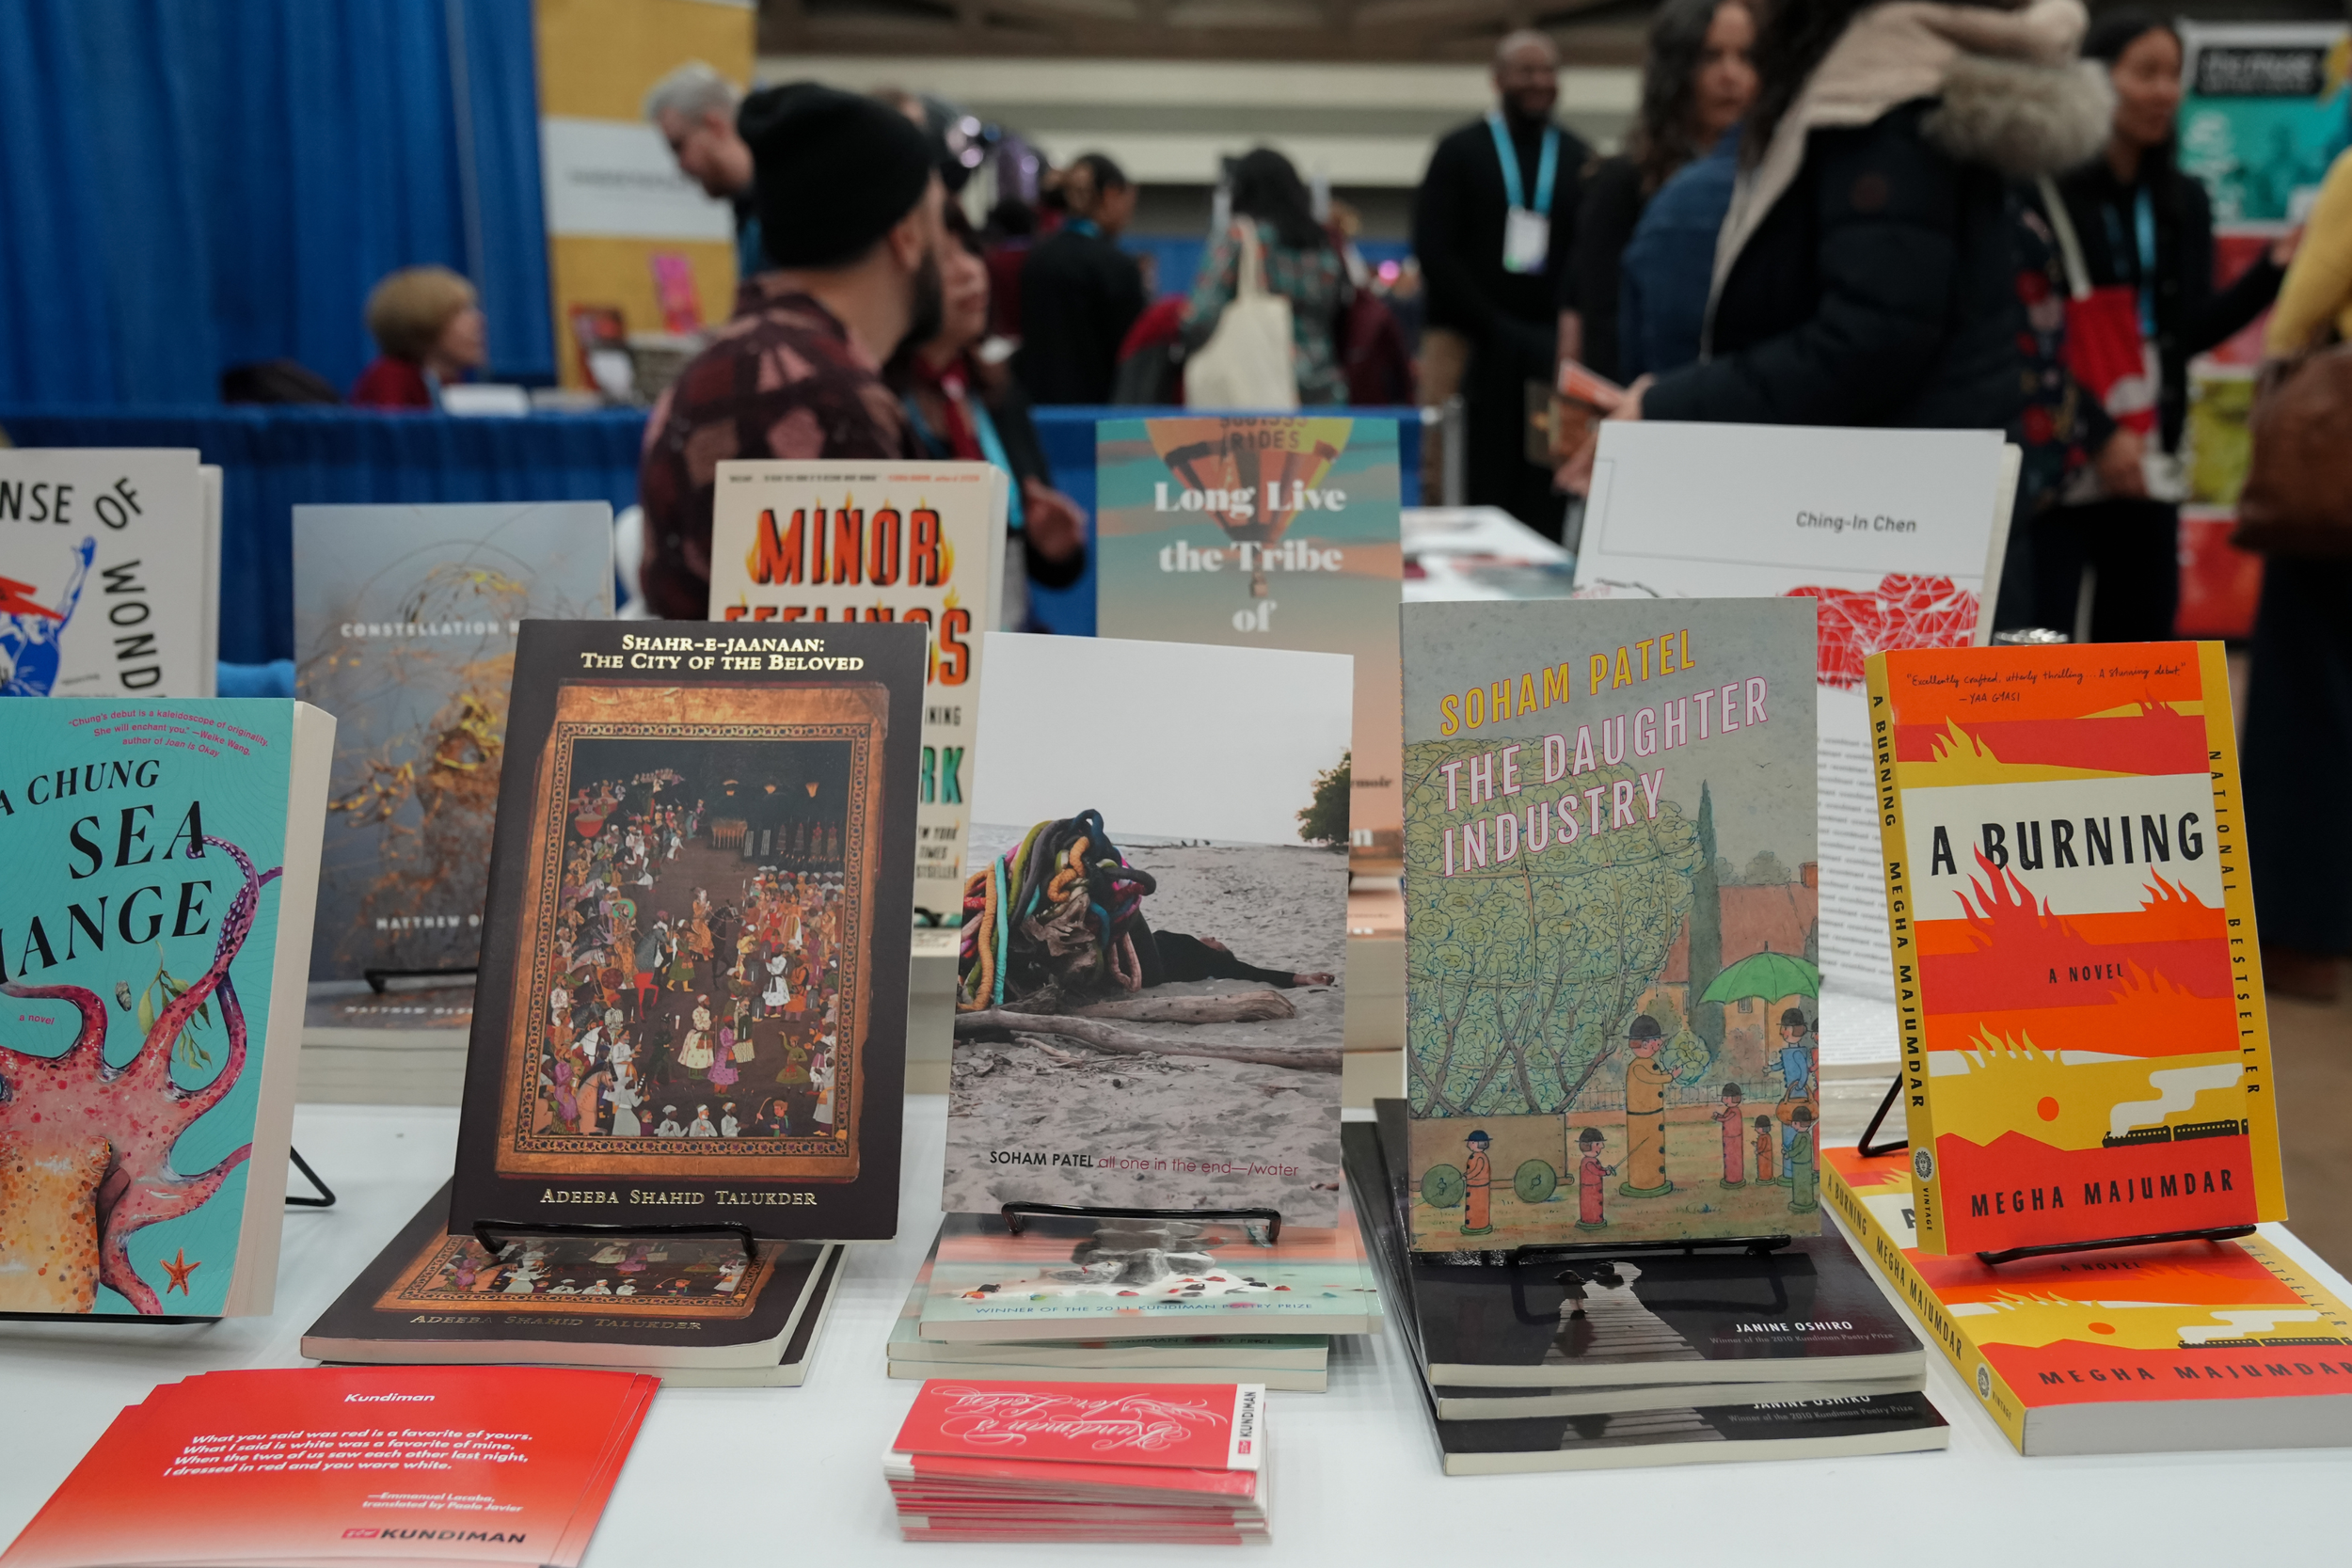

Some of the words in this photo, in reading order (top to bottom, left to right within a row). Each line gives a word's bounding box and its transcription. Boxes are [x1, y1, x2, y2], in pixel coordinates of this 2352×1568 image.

[95, 477, 143, 531] OF
[1154, 482, 1256, 519] Long
[1267, 480, 1347, 512] Live
[1796, 511, 1868, 533] Ching-In
[1874, 515, 1917, 532] Chen
[758, 508, 940, 587] MINOR
[1159, 539, 1223, 572] the
[1231, 538, 1343, 572] Tribe
[102, 560, 167, 697] WOND
[1232, 599, 1278, 633] of
[341, 621, 500, 638] CONSTELLATION
[689, 656, 715, 670] OF
[722, 656, 761, 671] THE
[1440, 661, 1569, 736] SOHAM
[1589, 628, 1695, 696] PATEL
[2006, 670, 2038, 684] utterly
[1872, 695, 1884, 709] A
[1992, 691, 2020, 703] GYASI
[94, 727, 111, 736] She
[114, 723, 129, 733] will
[132, 722, 167, 732] enchant
[110, 709, 135, 719] debut
[157, 709, 215, 725] kaleidoscope
[228, 725, 268, 747] originality.
[122, 736, 151, 745] author
[153, 736, 164, 745] of
[165, 738, 185, 748] Joan
[198, 744, 220, 758] Okay
[1440, 744, 1522, 811] THE
[1543, 676, 1769, 784] DAUGHTER
[27, 759, 160, 805] CHUNG
[1874, 720, 1897, 828] BURNING
[1443, 768, 1665, 879] INDUSTRY
[68, 800, 207, 879] SEA
[1931, 825, 1958, 876] A
[1981, 811, 2204, 871] BURNING
[1889, 862, 1908, 949] MEGHA
[0, 879, 213, 984] ANGE
[376, 914, 461, 929] MATTHEW
[2208, 751, 2237, 893] NATIONAL
[2228, 917, 2261, 1094] BESTSELLER
[2049, 967, 2058, 985] A
[2069, 963, 2124, 983] NOVEL
[19, 1013, 24, 1022] a
[27, 1012, 56, 1025] novel
[1899, 964, 1925, 1108] MAJUMDAR
[989, 1150, 1047, 1166] SOHAM
[1052, 1153, 1094, 1167] PATEL
[1098, 1153, 1116, 1169] all
[1119, 1158, 1150, 1170] one
[1154, 1156, 1167, 1171] in
[1171, 1157, 1197, 1173] the
[540, 1187, 620, 1204] ADEEBA
[629, 1189, 706, 1205] SHAHID
[715, 1190, 818, 1206] TALUKDER
[1971, 1185, 2065, 1217] MEGHA
[2084, 1168, 2234, 1206] MAJUMDAR
[1922, 1187, 1933, 1232] VINTAGE
[2081, 1261, 2142, 1271] NOVEL
[2242, 1243, 2348, 1326] BESTSELLER
[1826, 1174, 1833, 1191] A
[1835, 1182, 1867, 1236] BURNING
[1876, 1236, 1906, 1287] MEGHA
[1909, 1278, 1963, 1361] MAJUMDAR
[1992, 1390, 2012, 1421] VINTAGE
[1736, 1323, 1790, 1333] JANINE
[1794, 1321, 1853, 1332] OSHIRO
[1795, 1334, 1842, 1342] Kundiman
[2039, 1366, 2156, 1386] MEGHA
[2173, 1361, 2352, 1381] MAJUMDAR
[344, 1393, 436, 1402] Kundiman
[1238, 1390, 1258, 1438] KUNDIMAN
[183, 1445, 227, 1454] What
[229, 1443, 236, 1451] I
[237, 1442, 273, 1451] said
[273, 1441, 286, 1450] is
[290, 1440, 335, 1449] white
[388, 1439, 451, 1449] favorite
[453, 1440, 473, 1449] of
[472, 1441, 516, 1450] mine.
[192, 1434, 235, 1444] What
[235, 1433, 267, 1443] you
[269, 1431, 304, 1440] said
[341, 1429, 370, 1437] red
[371, 1429, 384, 1437] is
[401, 1428, 463, 1438] favorite
[466, 1430, 485, 1438] of
[485, 1433, 533, 1441] yours.
[163, 1467, 173, 1477] I
[172, 1464, 237, 1476] dressed
[238, 1464, 254, 1472] in
[257, 1462, 288, 1471] red
[288, 1461, 323, 1470] and
[321, 1462, 354, 1471] you
[404, 1461, 453, 1470] white.
[174, 1456, 220, 1465] When
[223, 1453, 249, 1463] the
[252, 1452, 285, 1461] two
[287, 1450, 307, 1460] of
[364, 1449, 402, 1458] each
[405, 1449, 449, 1459] other
[451, 1450, 481, 1460] last
[483, 1452, 529, 1463] night,
[362, 1500, 426, 1509] translated
[428, 1500, 446, 1511] by
[380, 1528, 527, 1544] KUNDIMAN
